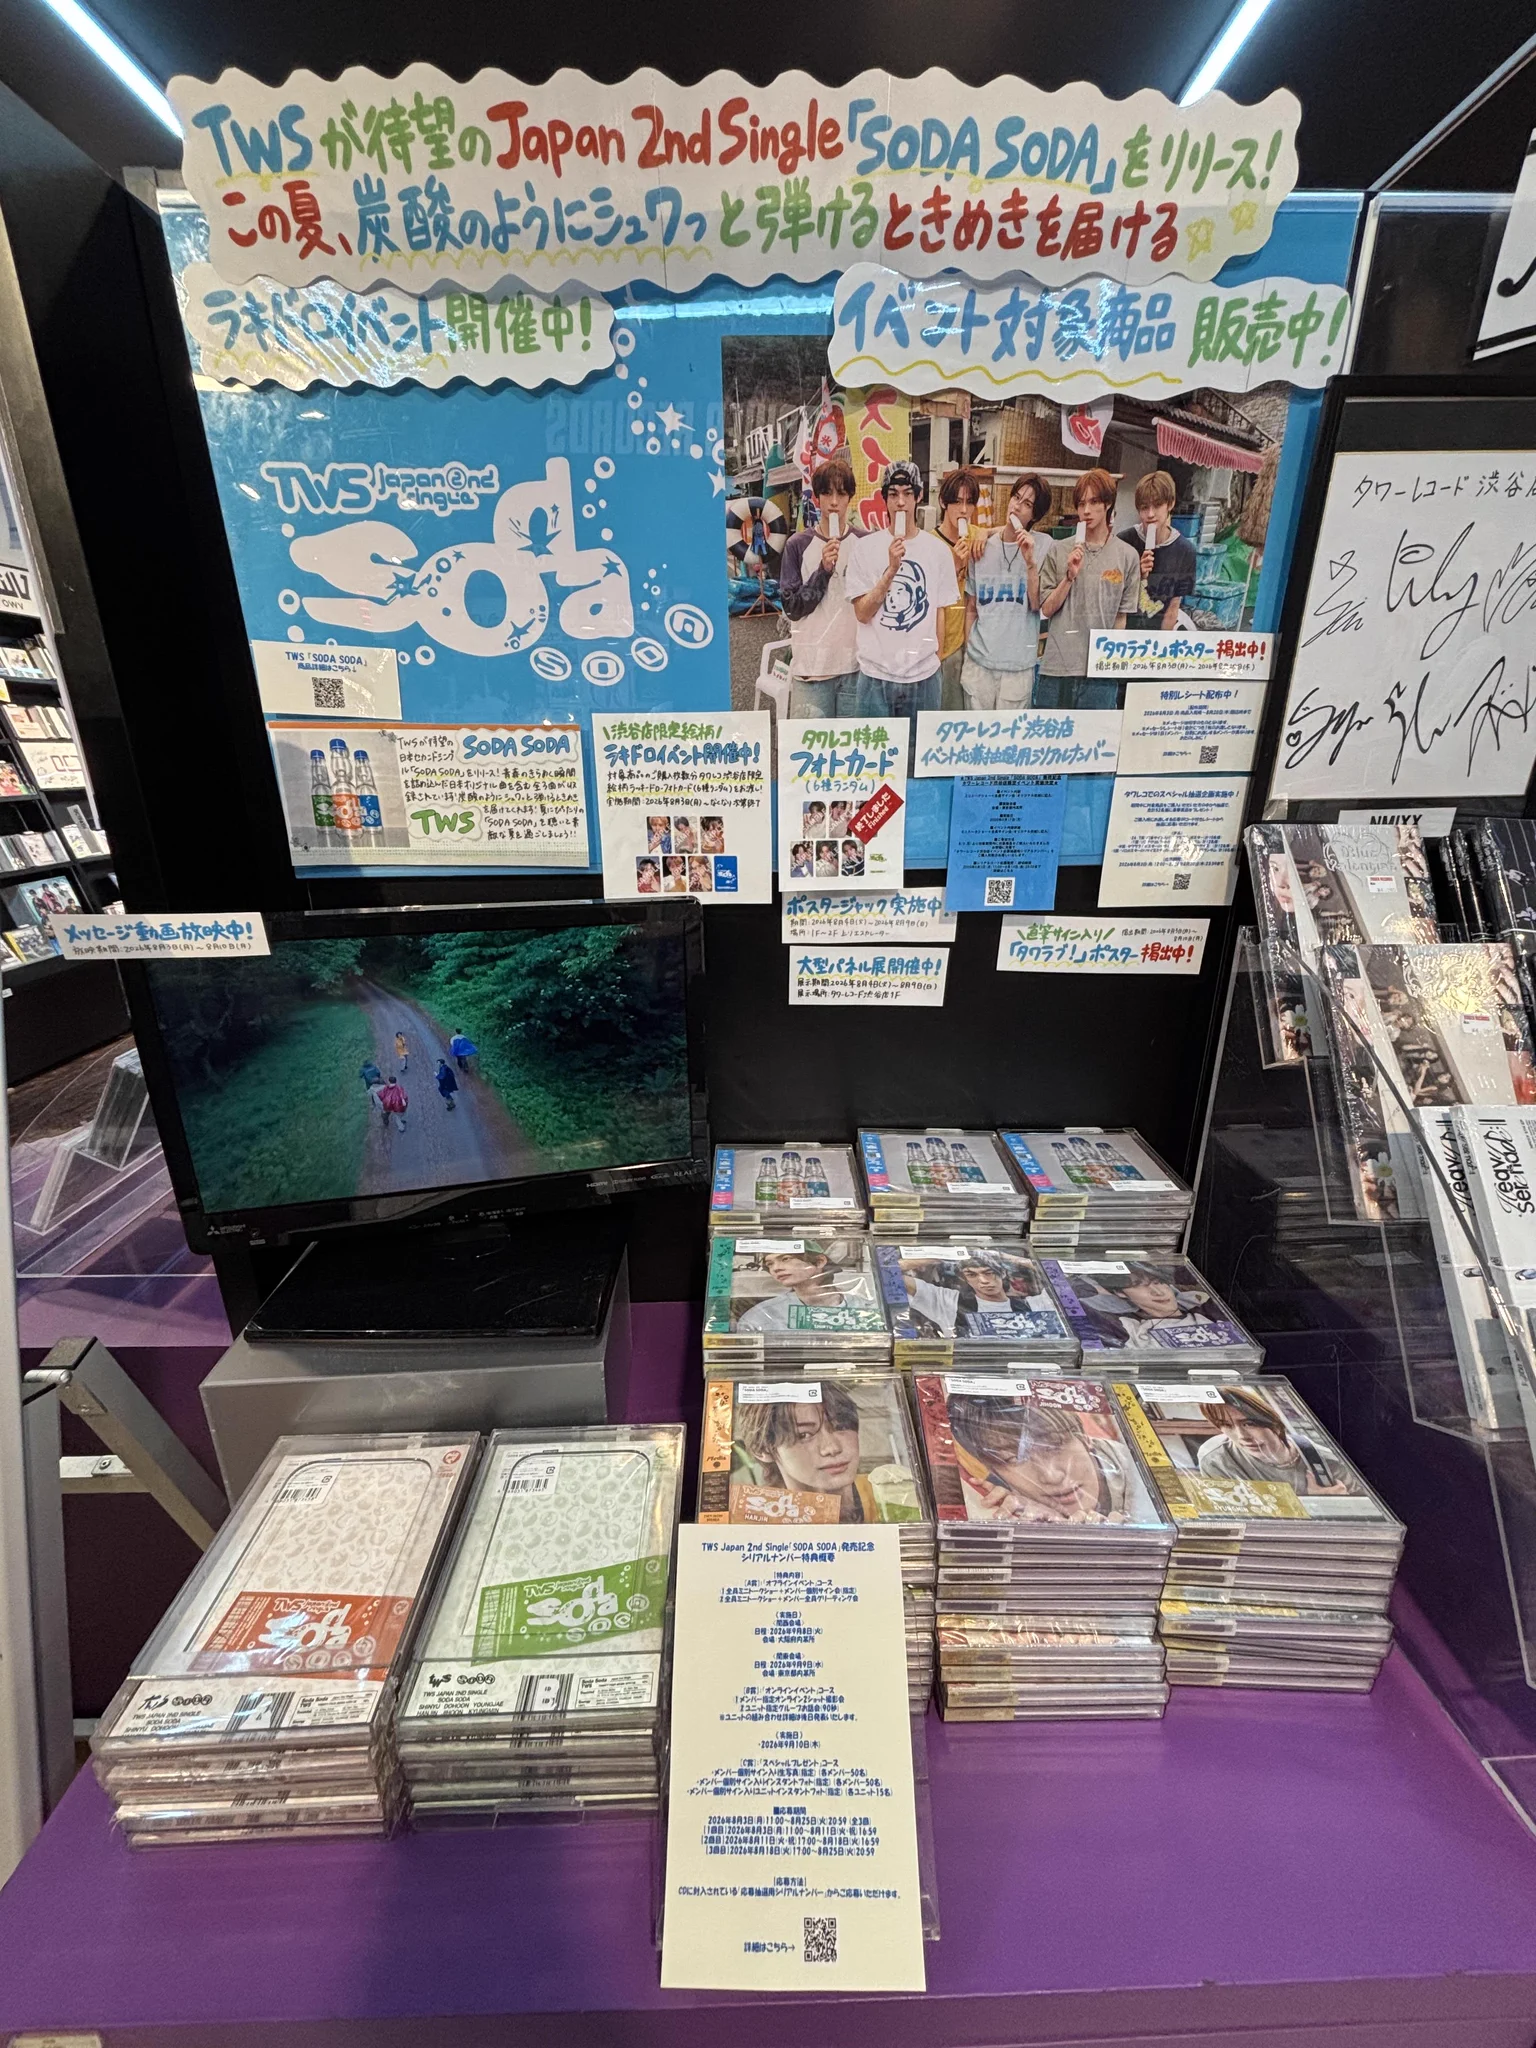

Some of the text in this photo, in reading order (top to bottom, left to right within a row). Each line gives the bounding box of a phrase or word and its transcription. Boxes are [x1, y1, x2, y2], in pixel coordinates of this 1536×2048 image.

[192, 104, 314, 177] TWS
[487, 100, 625, 178] Japan
[632, 105, 711, 168] 2nd
[719, 97, 843, 173] Single
[260, 461, 376, 514] TWS
[285, 651, 304, 661] TWS
[463, 734, 571, 760] SODA SODA
[790, 747, 898, 778] フォトカード
[411, 808, 476, 835] TWS
[702, 1542, 763, 1553] TWS Japan 2nd
